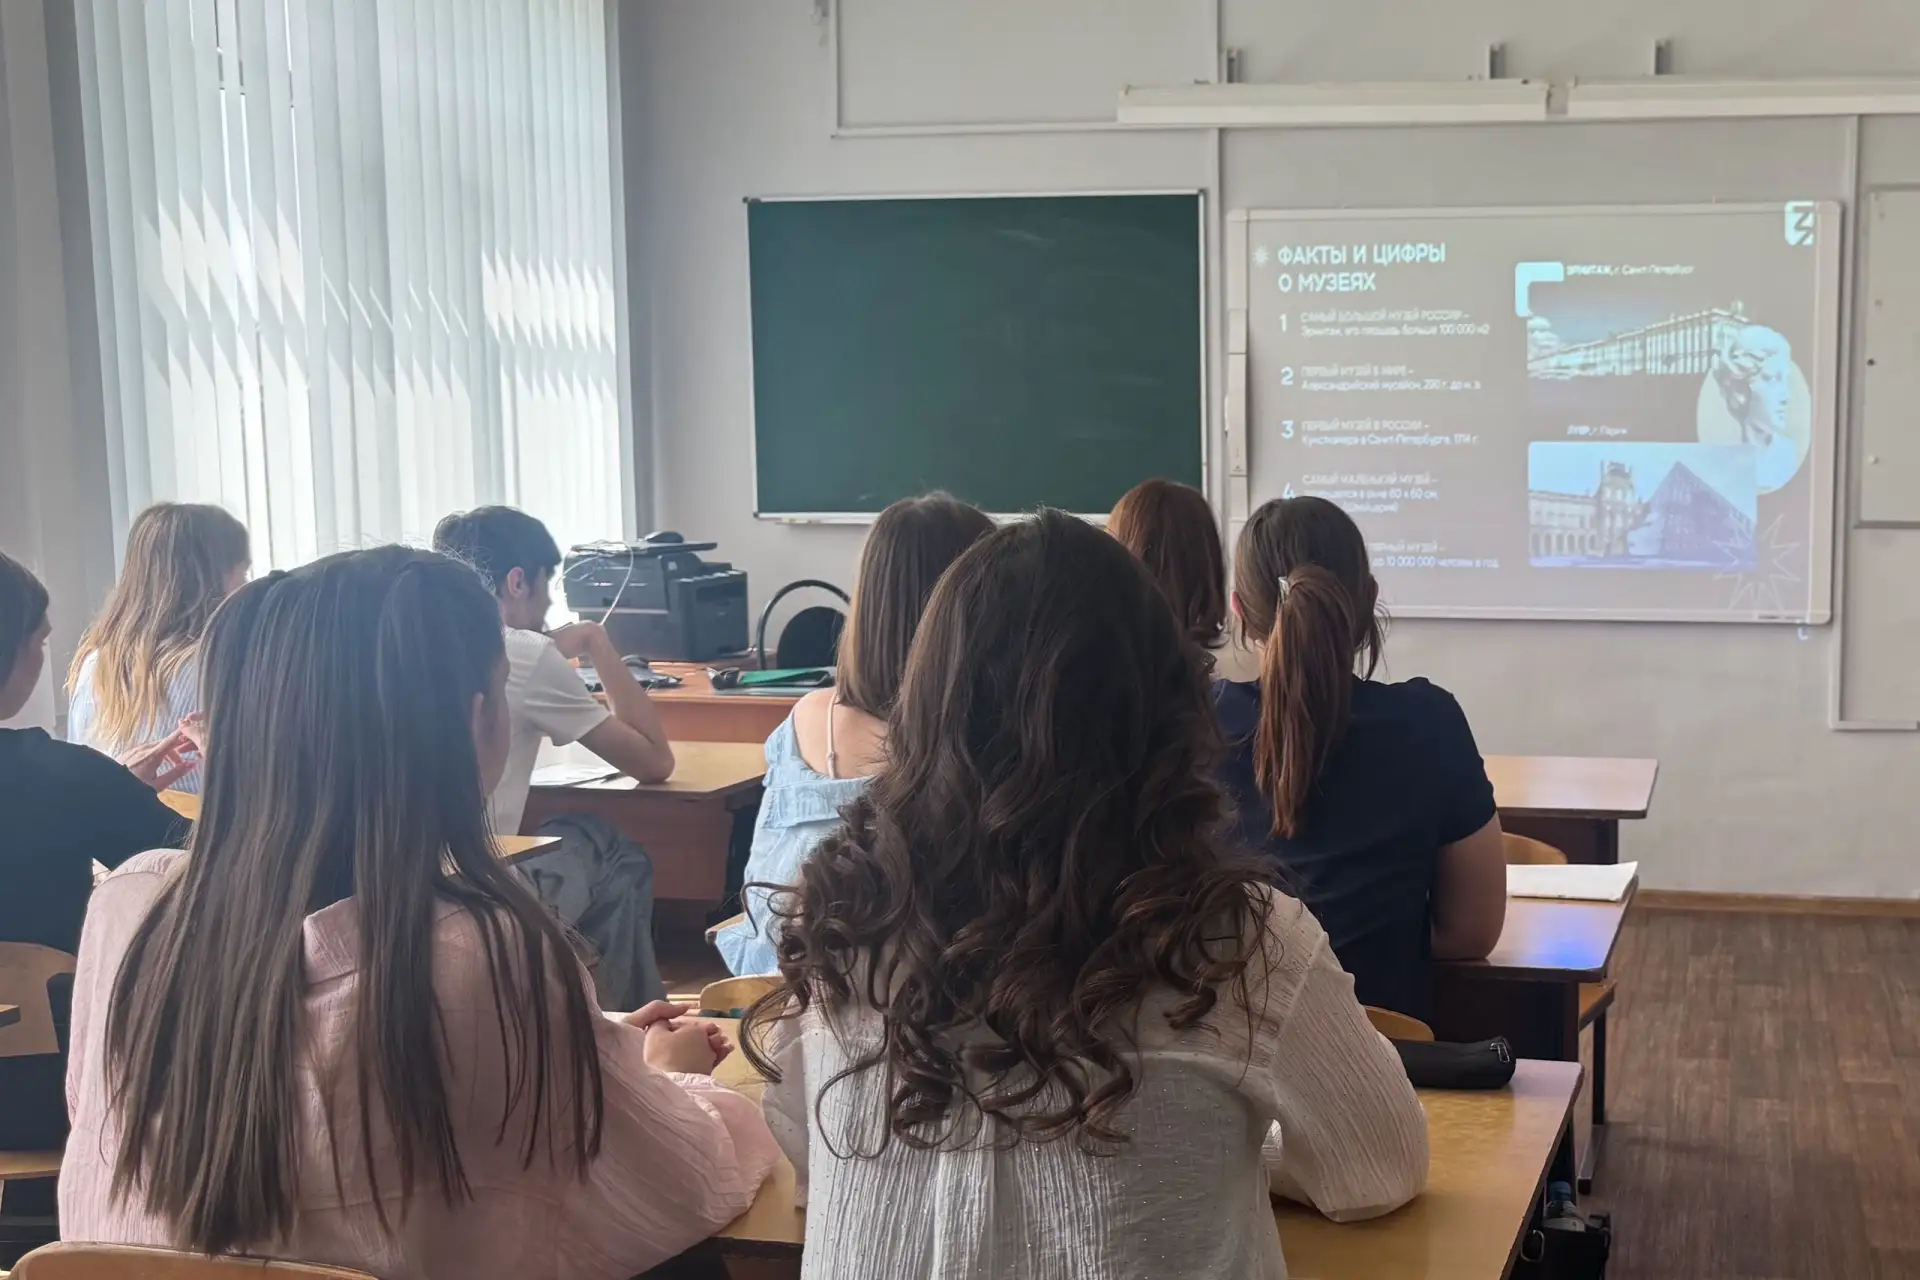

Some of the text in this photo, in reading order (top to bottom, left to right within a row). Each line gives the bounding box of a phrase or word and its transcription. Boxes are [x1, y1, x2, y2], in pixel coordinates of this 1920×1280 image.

[1277, 242, 1446, 266] ФАКТЫ И ЦИФРЫ
[1278, 272, 1376, 293] О МУЗЕЯХ
[1279, 314, 1287, 332] 1
[1280, 366, 1294, 386] 2
[1281, 420, 1294, 439] 3
[1283, 482, 1296, 499] 4
